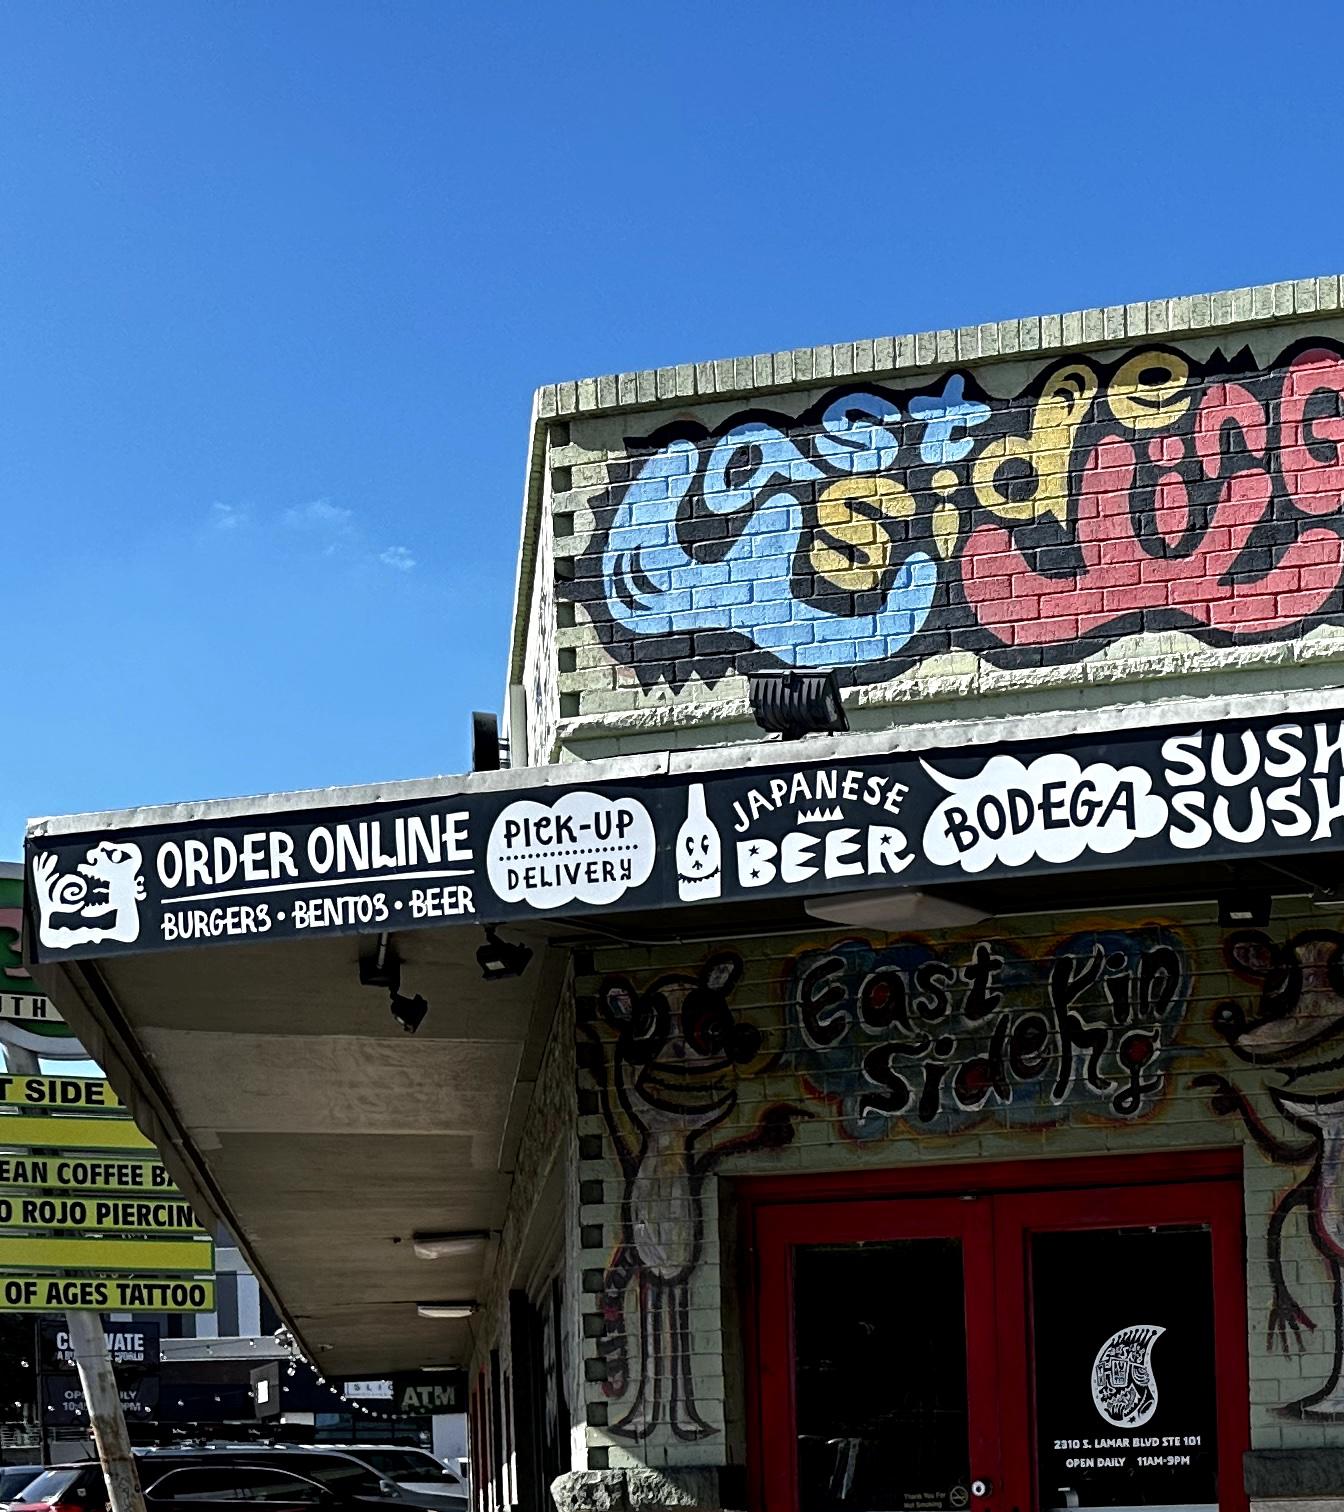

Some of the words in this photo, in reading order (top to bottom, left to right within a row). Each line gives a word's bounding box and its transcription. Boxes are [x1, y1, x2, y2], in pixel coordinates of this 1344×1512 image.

[733, 769, 909, 833] JAPANESE
[504, 809, 635, 849] PICK-UP
[943, 780, 1138, 854] BODEGA
[156, 831, 299, 889] ORDER
[307, 811, 474, 875] ONLINE
[736, 825, 916, 888] BEER
[506, 858, 634, 892] DELIVERY
[161, 903, 272, 942] BURGERS
[292, 892, 389, 930] BENTOS
[409, 885, 476, 919] BEER
[0, 995, 47, 1018] TH
[25, 1079, 105, 1106] SIDE
[57, 1163, 143, 1187] COFFEE
[22, 1200, 87, 1224] ROJO
[5, 1281, 38, 1305] OF
[46, 1282, 108, 1306] AGES
[116, 1283, 206, 1307] TATTOO
[401, 1385, 456, 1408] ATM
[1095, 1438, 1130, 1449] LAMAR
[1133, 1437, 1160, 1448] BLVD
[1162, 1437, 1181, 1447] STE
[1184, 1436, 1201, 1446] 101
[1065, 1457, 1095, 1468] OPEN
[1097, 1457, 1126, 1467] DAILY
[1137, 1455, 1191, 1467] 11AM-9PM
